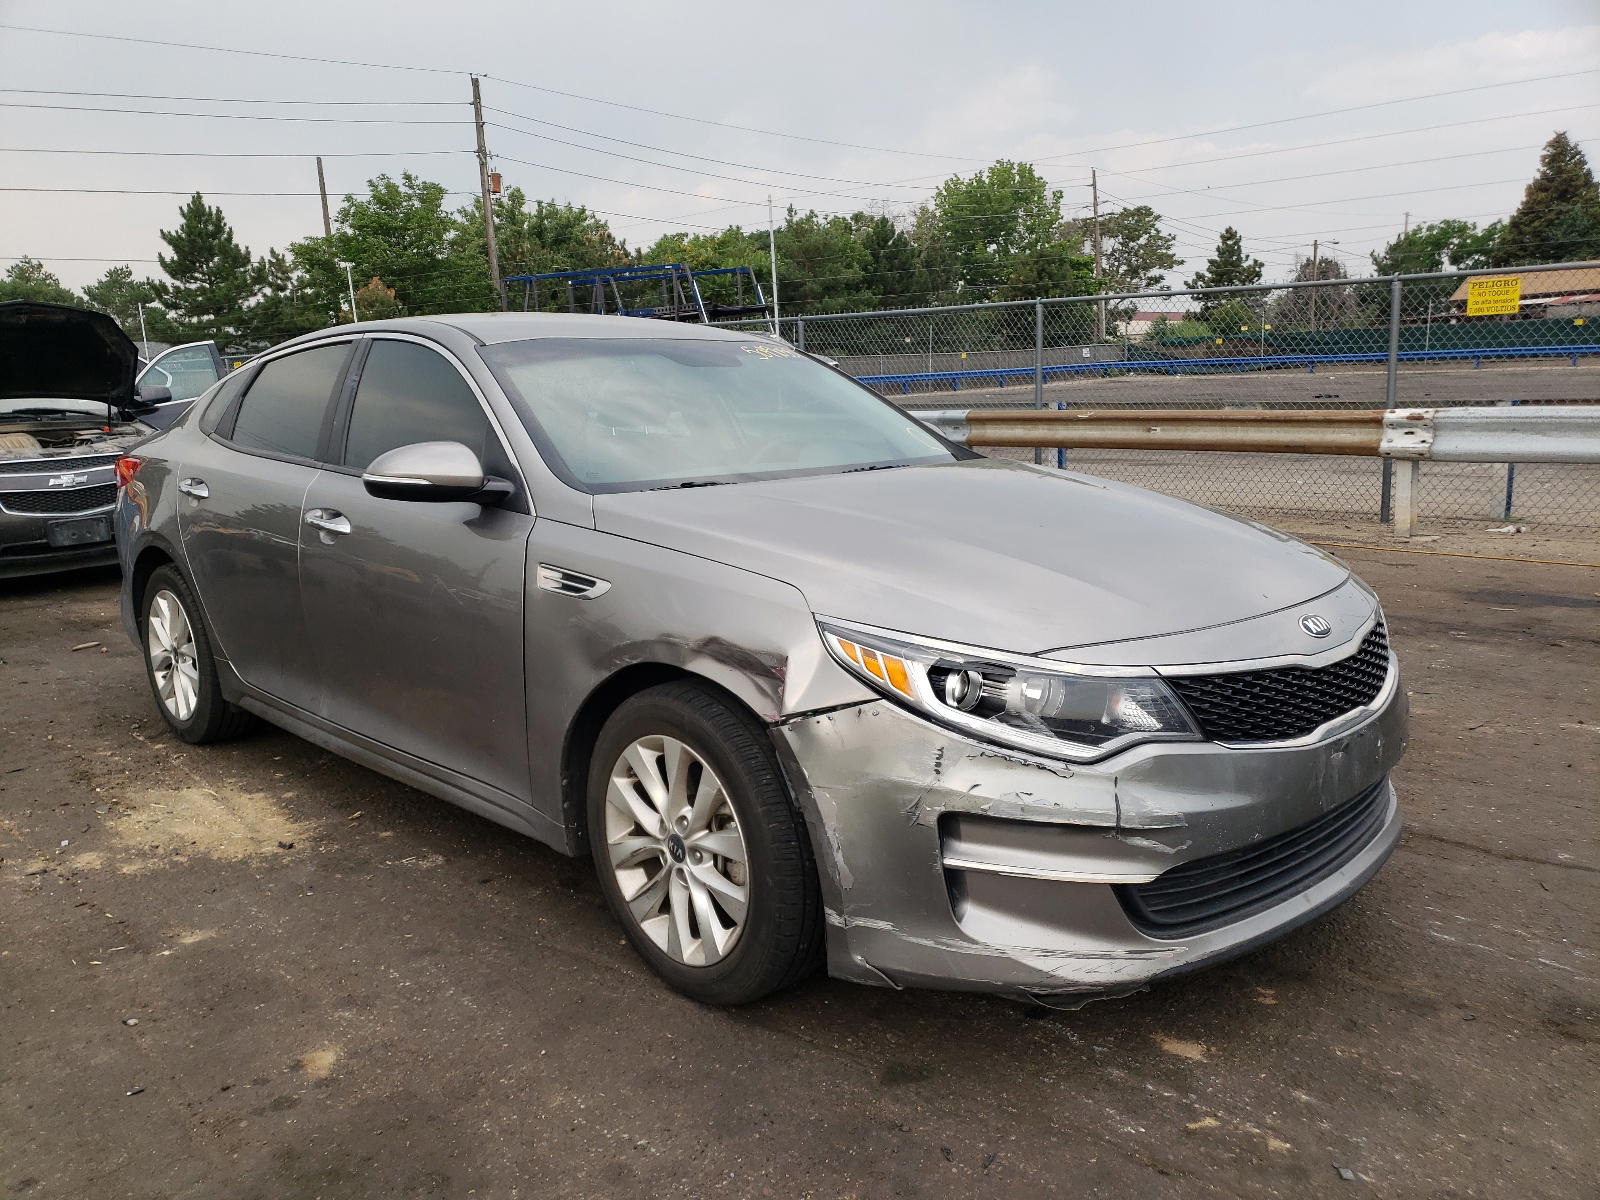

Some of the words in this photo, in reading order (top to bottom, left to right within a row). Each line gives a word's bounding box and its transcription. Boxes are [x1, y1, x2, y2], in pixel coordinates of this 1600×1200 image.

[1472, 280, 1518, 289] PELIGRO
[1303, 616, 1331, 634] KIA
[668, 840, 683, 860] KIA
